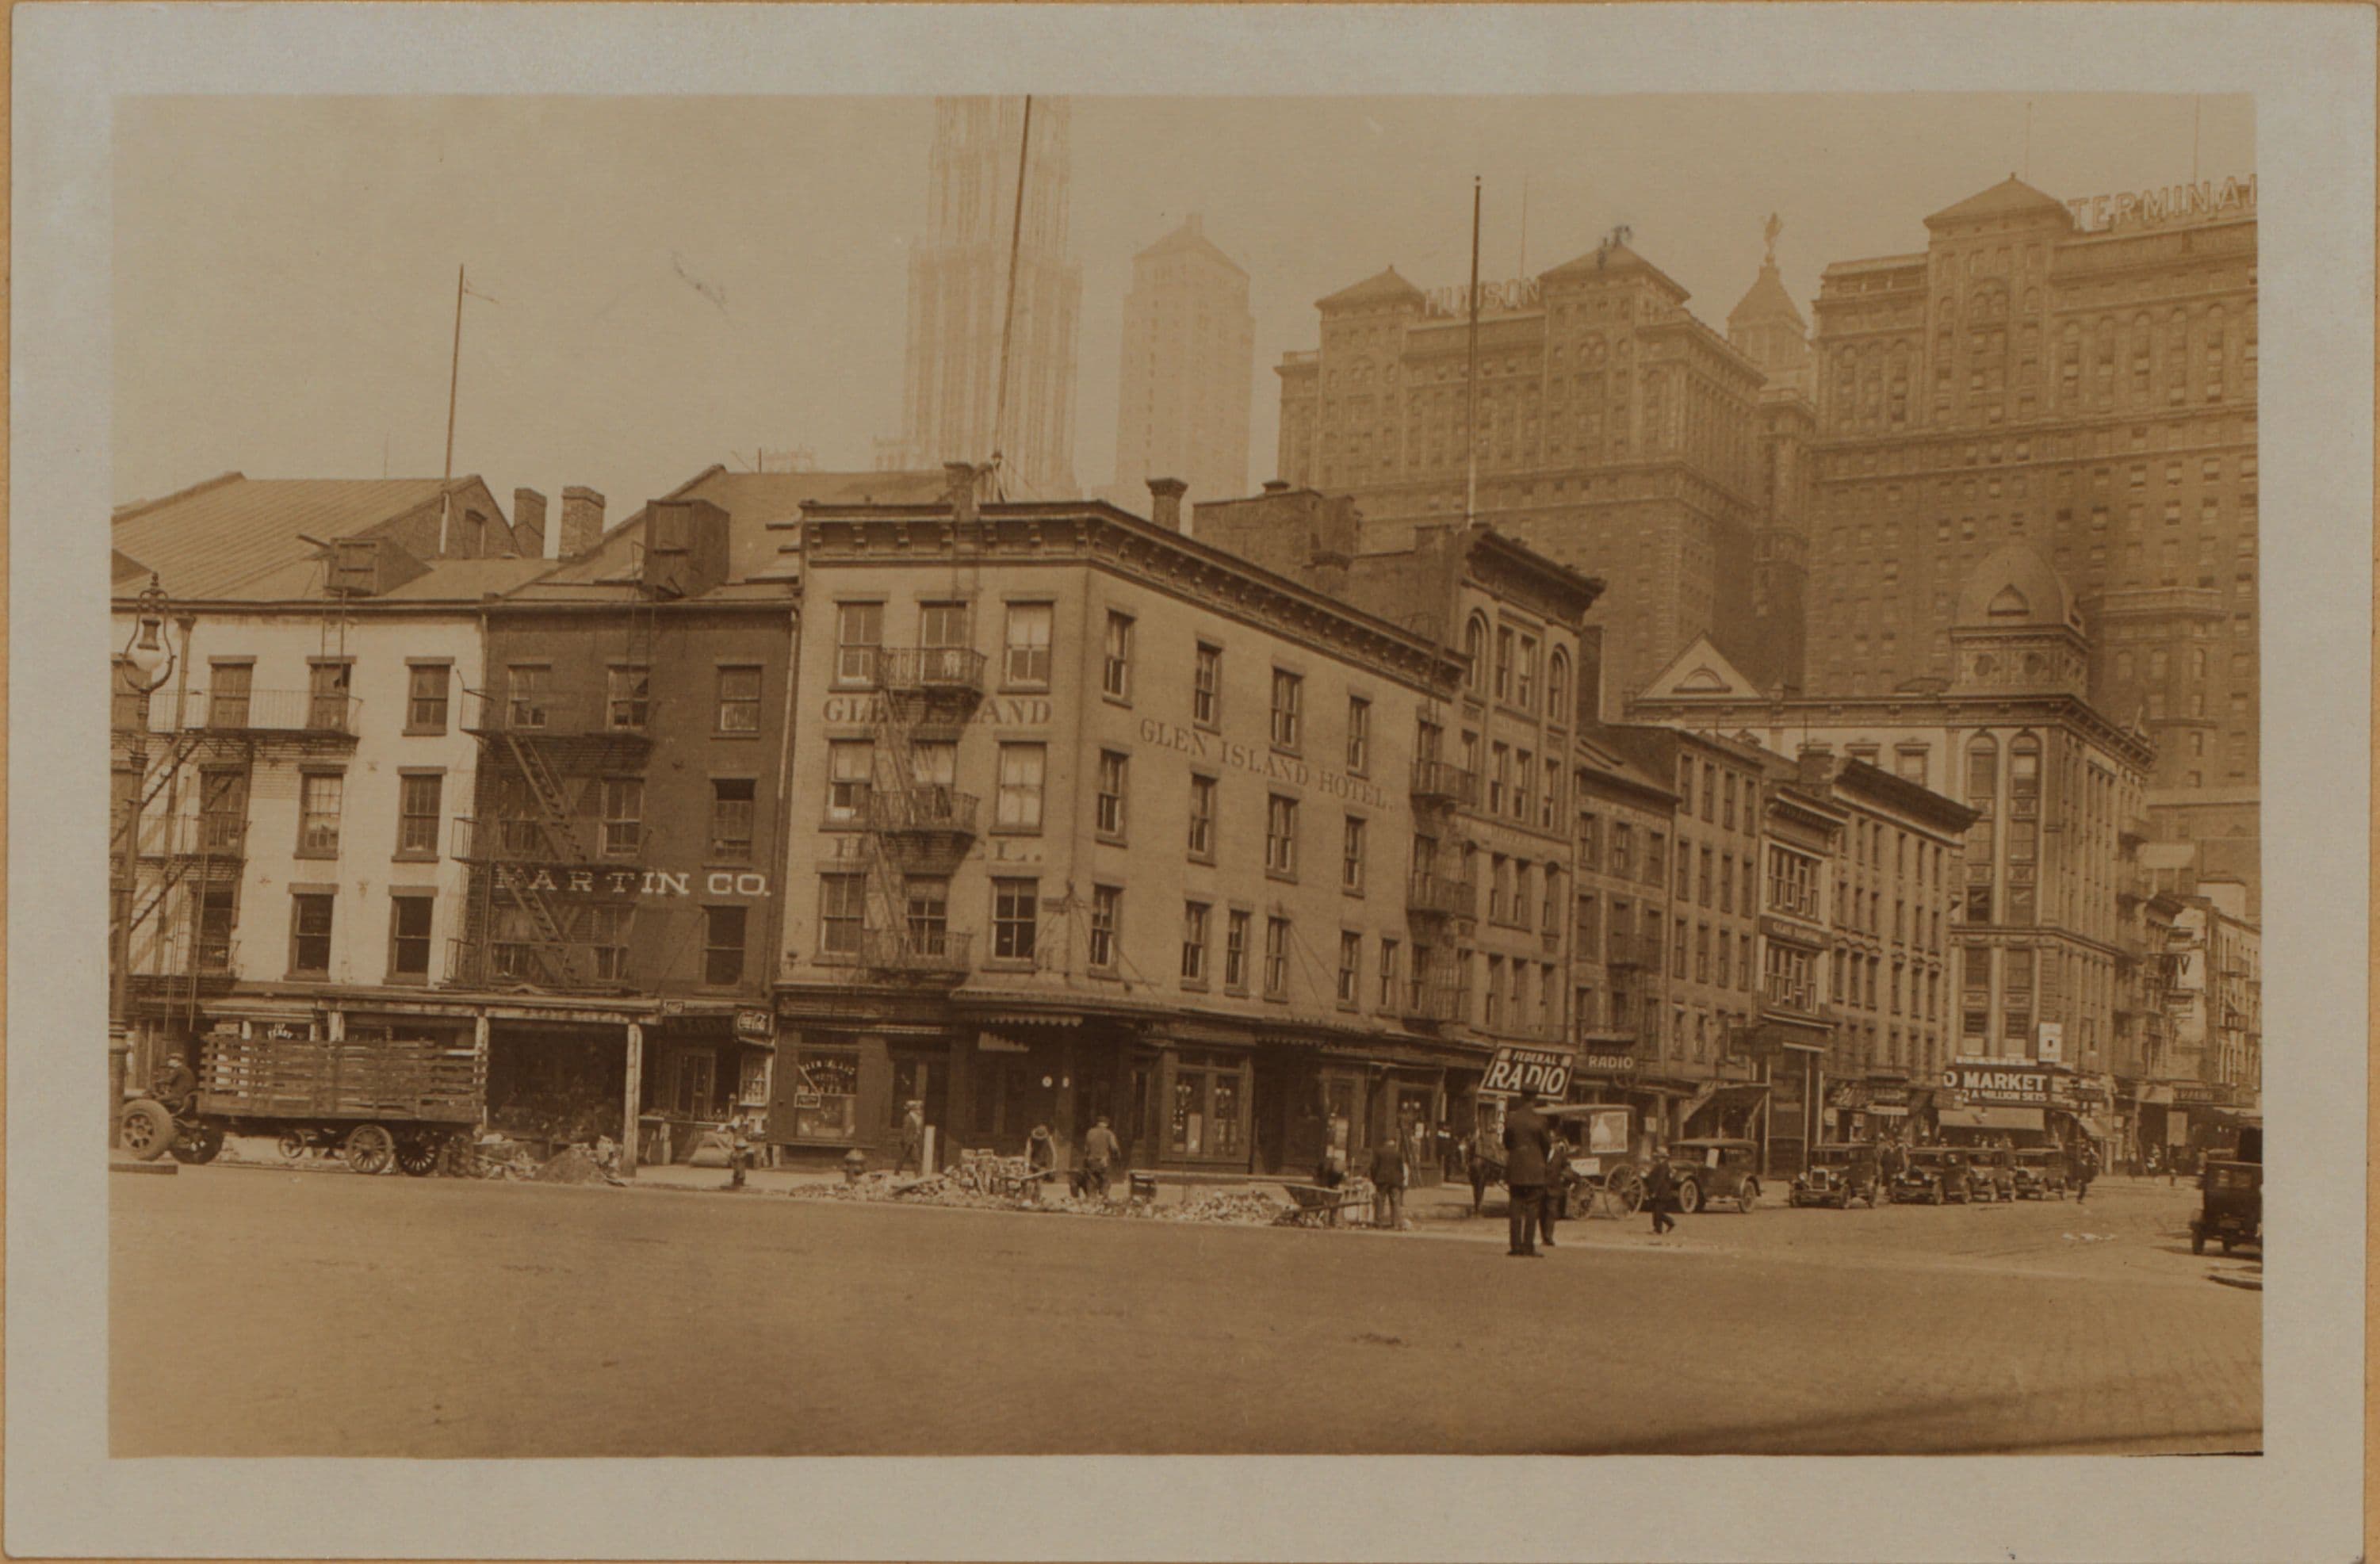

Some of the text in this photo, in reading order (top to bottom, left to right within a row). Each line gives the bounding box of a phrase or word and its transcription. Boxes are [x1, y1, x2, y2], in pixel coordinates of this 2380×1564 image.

[1140, 718, 1209, 757] GLEN
[1221, 742, 1309, 787] ISLAND
[707, 872, 772, 897] CO.
[1513, 1050, 1557, 1065] FEDERAL
[1588, 1055, 1634, 1069] RADIO
[1487, 1061, 1567, 1094] RADIO
[1963, 1071, 2047, 1091] MARKET
